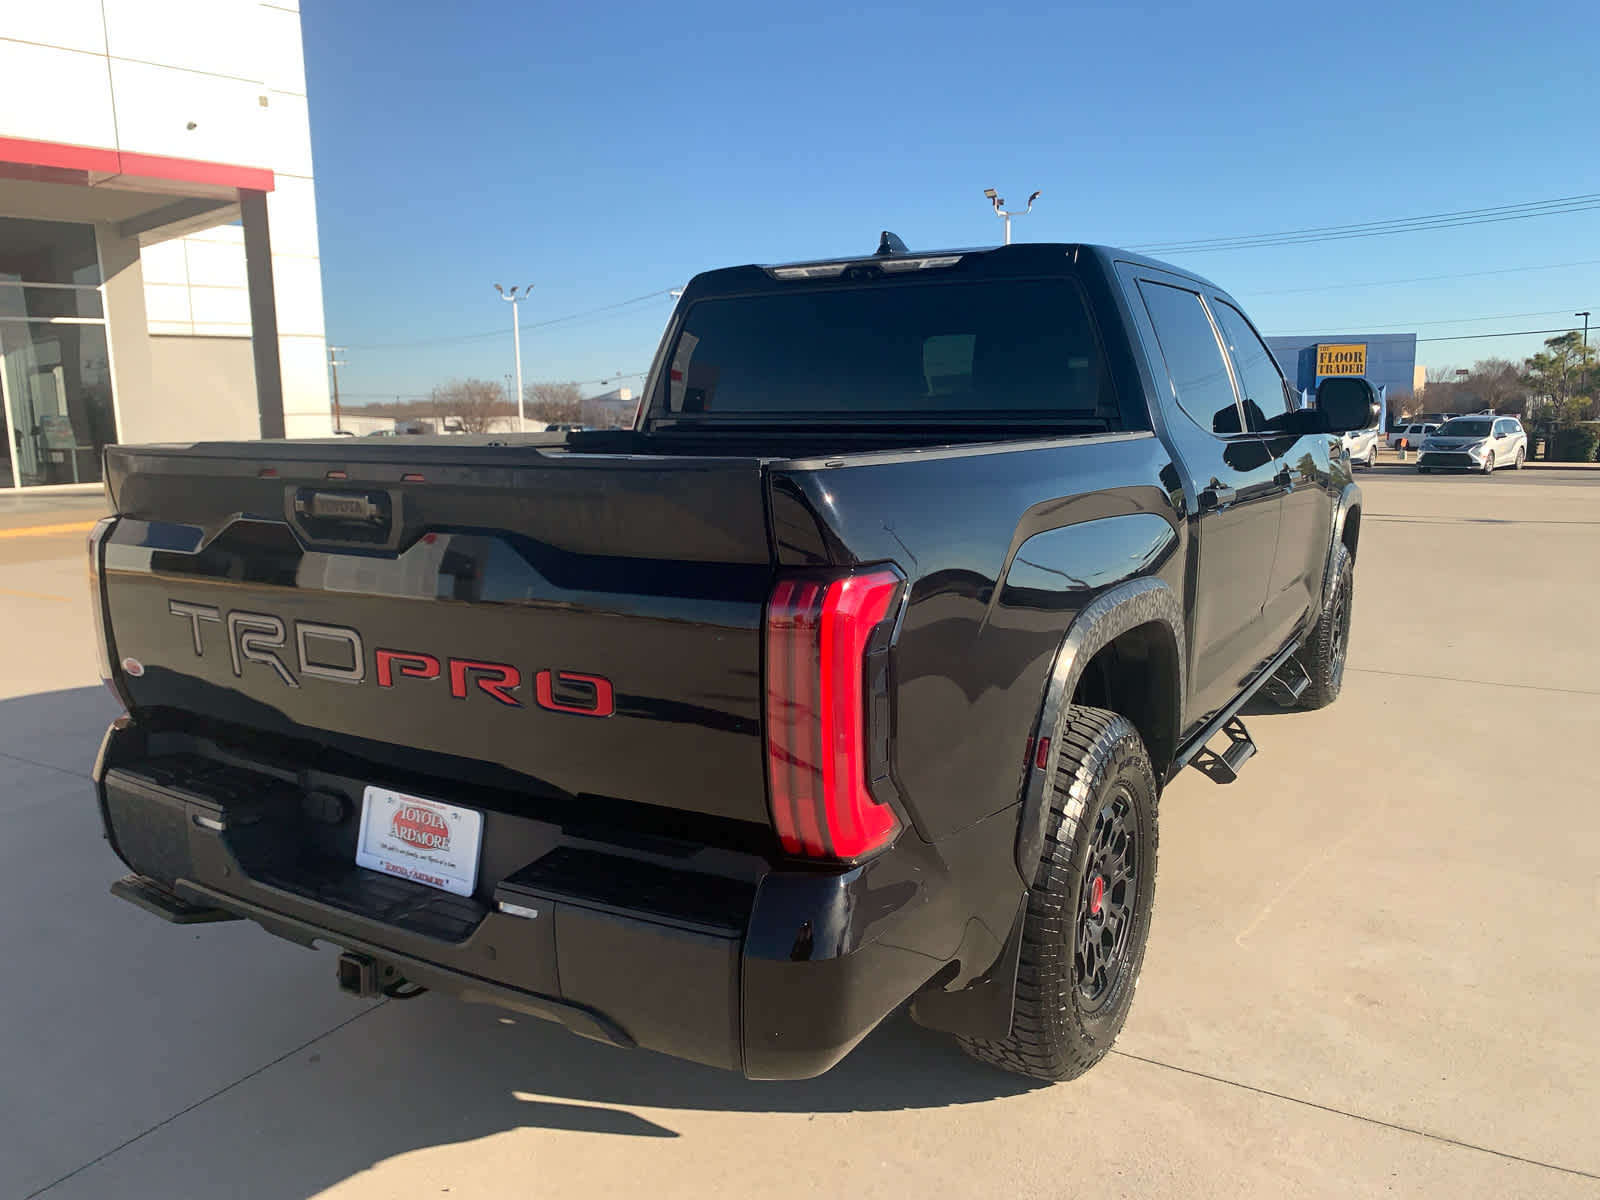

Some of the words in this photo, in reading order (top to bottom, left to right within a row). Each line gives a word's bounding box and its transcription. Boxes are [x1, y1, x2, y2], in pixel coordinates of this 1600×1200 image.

[1319, 364, 1363, 374] TRADER
[1320, 352, 1362, 363] FLOOR
[168, 598, 366, 688] TRD
[376, 647, 616, 718] PRO
[399, 805, 445, 829] TOYOTA
[389, 824, 451, 851] ARDMORE
